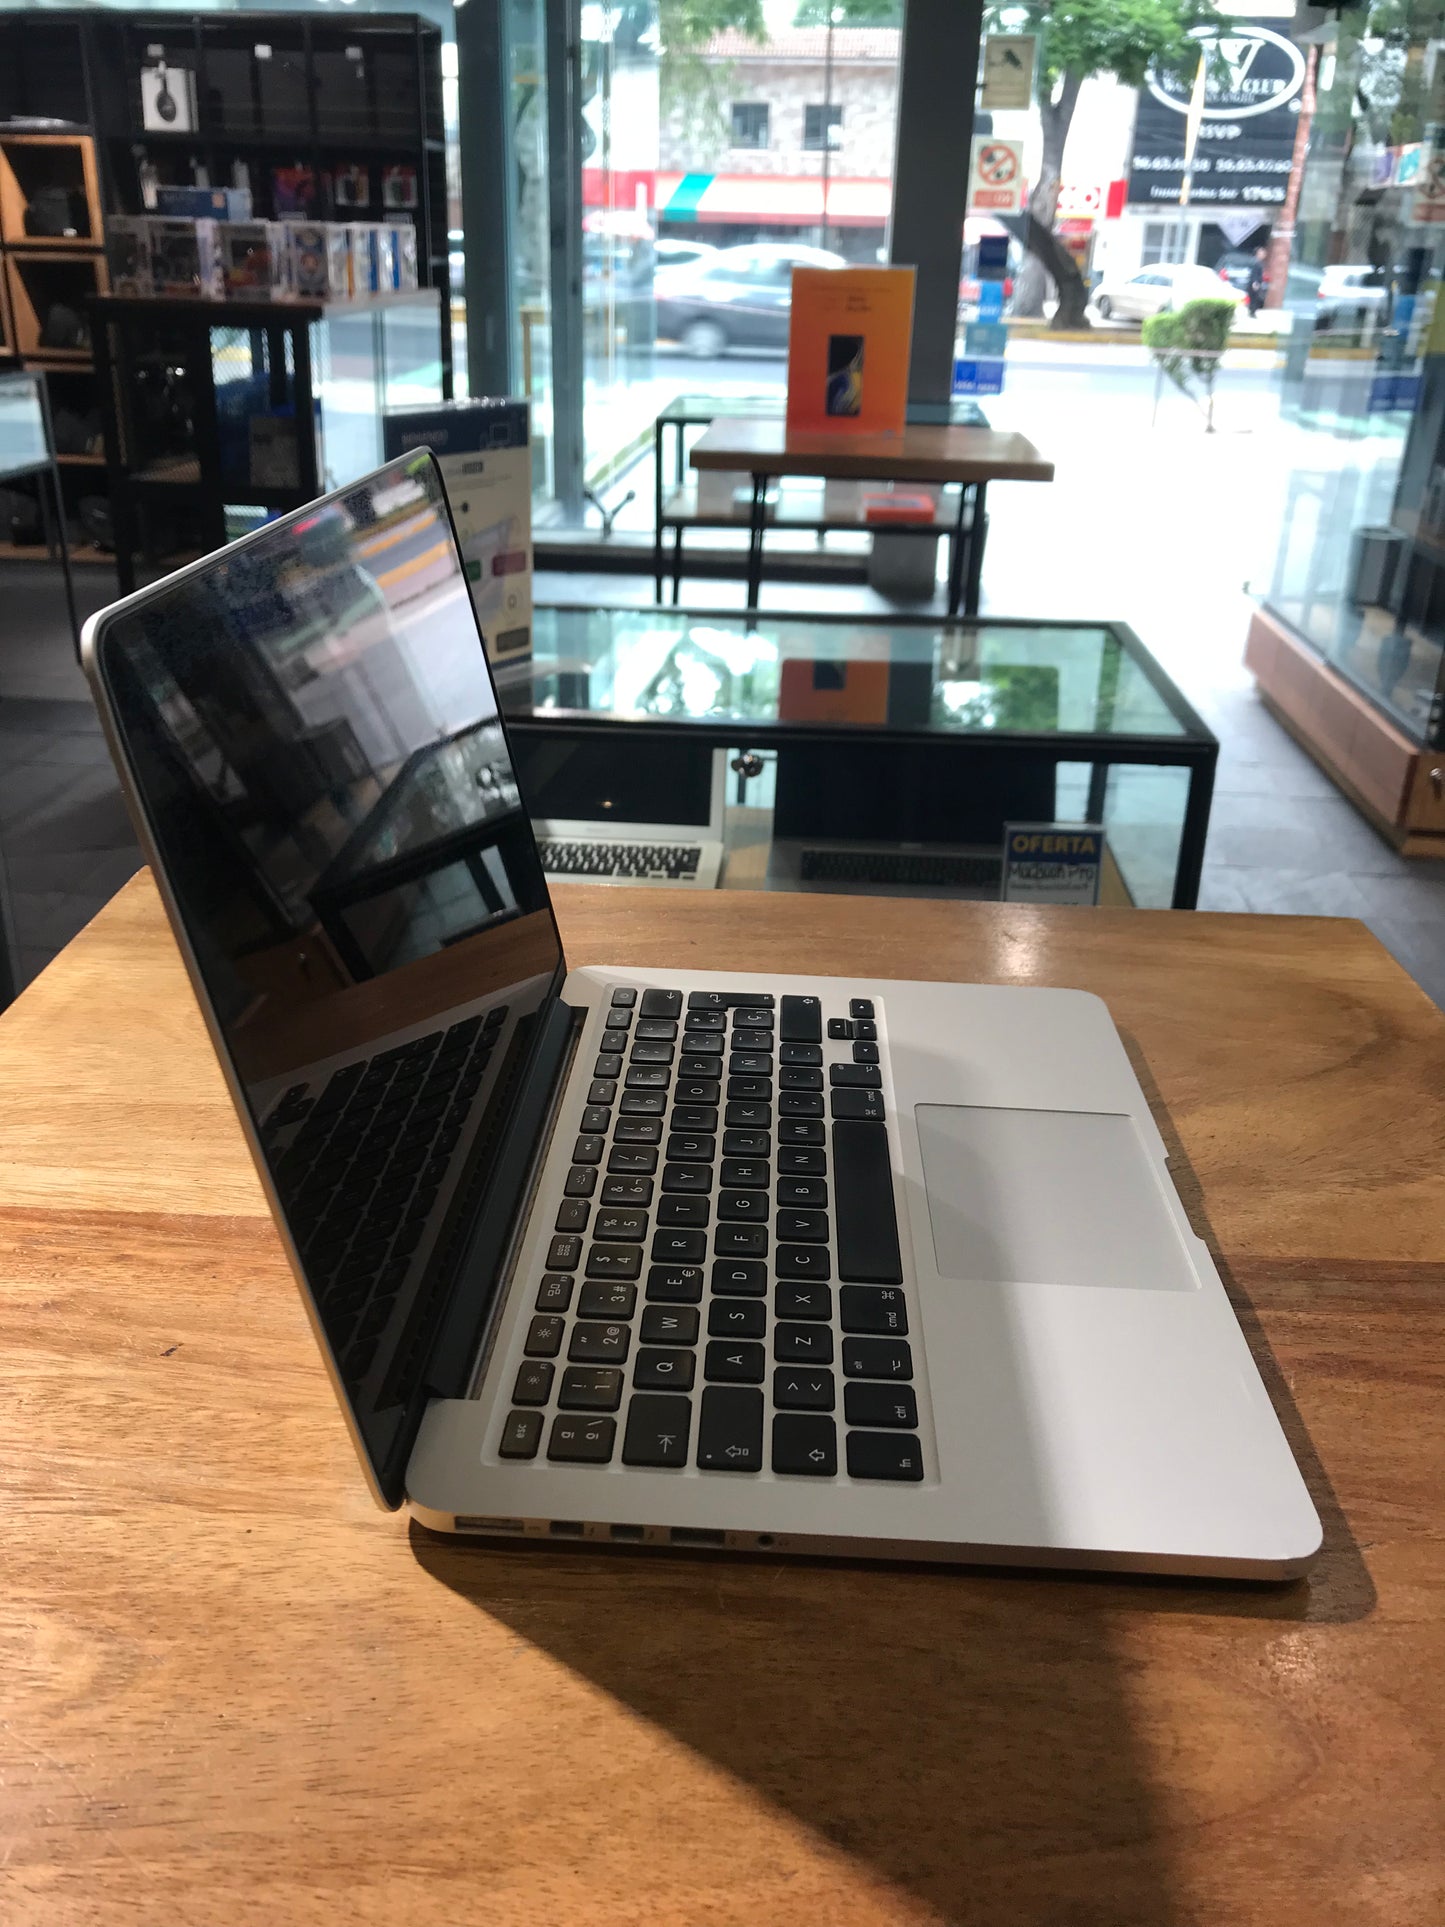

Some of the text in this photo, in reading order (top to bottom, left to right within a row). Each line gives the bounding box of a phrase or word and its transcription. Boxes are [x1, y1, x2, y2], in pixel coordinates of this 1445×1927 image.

[1011, 835, 1096, 854] OFERTA
[690, 1087, 704, 1095] O
[794, 1126, 809, 1135] M
[684, 1142, 698, 1150] U
[795, 1156, 809, 1164] N
[738, 1168, 752, 1176] H
[610, 1185, 624, 1193] &
[735, 1200, 750, 1208] G
[603, 1218, 618, 1227] %
[795, 1220, 810, 1228] V
[795, 1256, 810, 1264] C
[731, 1271, 747, 1280] D
[667, 1278, 683, 1286] E
[795, 1294, 811, 1304] X
[729, 1312, 745, 1320] S
[885, 1311, 897, 1328] cmd
[661, 1317, 679, 1329] W
[602, 1336, 619, 1345] 2
[795, 1336, 812, 1346] Z
[726, 1354, 743, 1365] A
[656, 1362, 674, 1373] Q
[894, 1405, 907, 1419] ctrl
[516, 1423, 527, 1439] esc
[899, 1458, 911, 1468] fn
